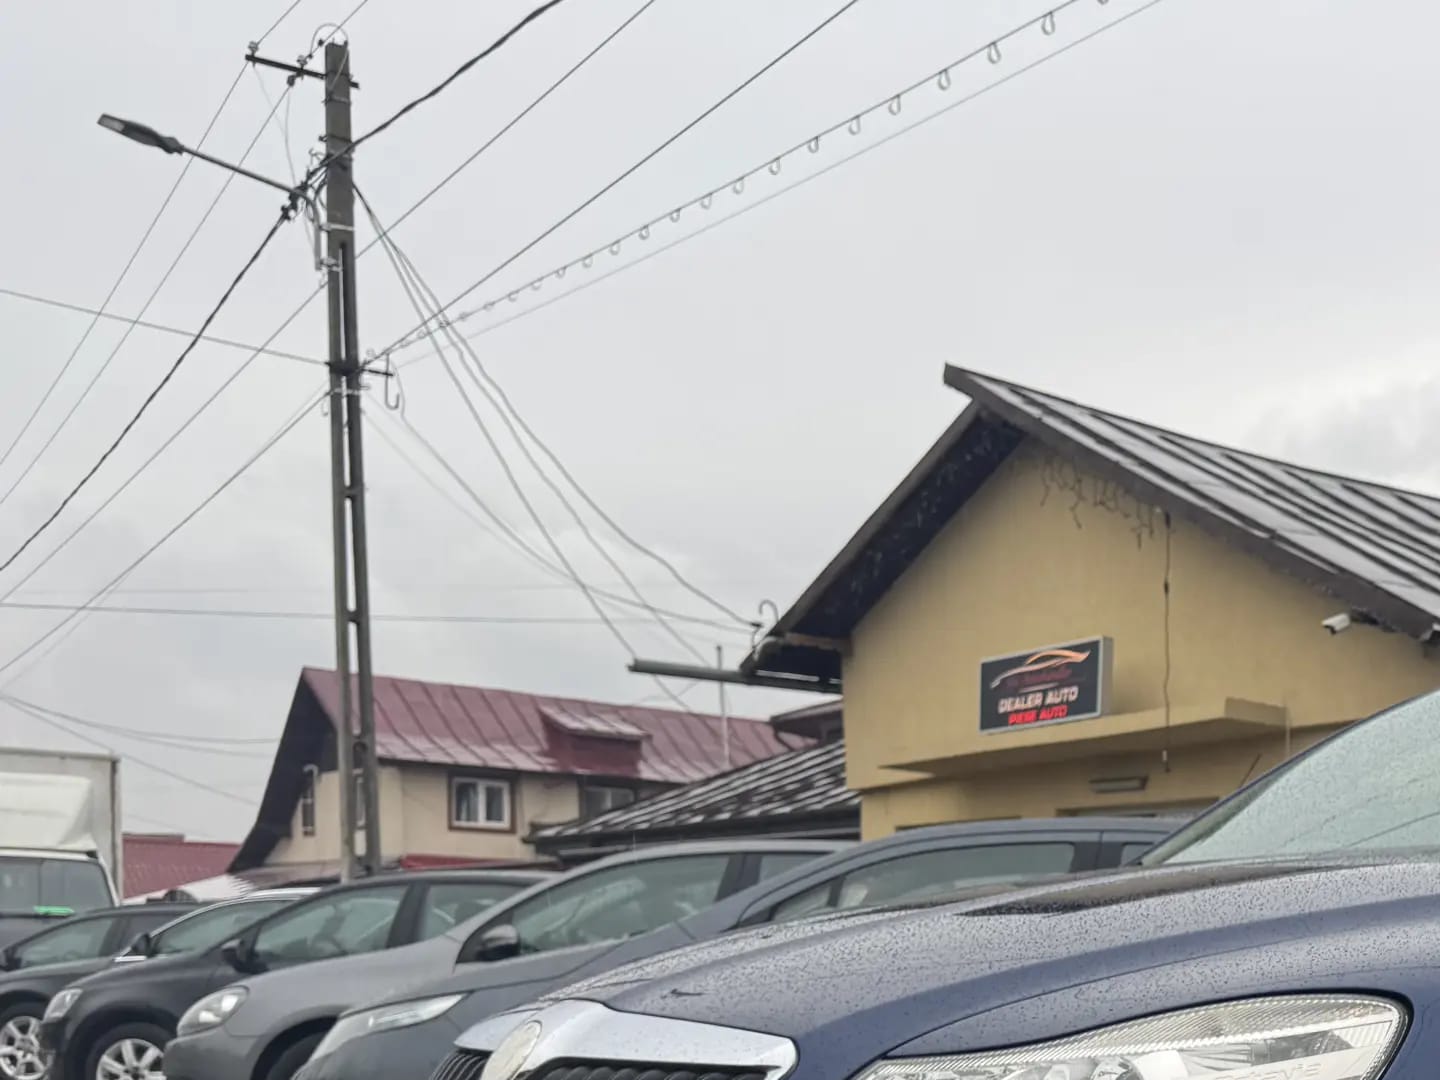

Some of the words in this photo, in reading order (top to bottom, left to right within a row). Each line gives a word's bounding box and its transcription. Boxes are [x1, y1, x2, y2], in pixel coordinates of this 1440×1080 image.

[998, 692, 1043, 714] DEALER
[1044, 685, 1079, 705] AUTO
[1039, 704, 1068, 720] AUTO
